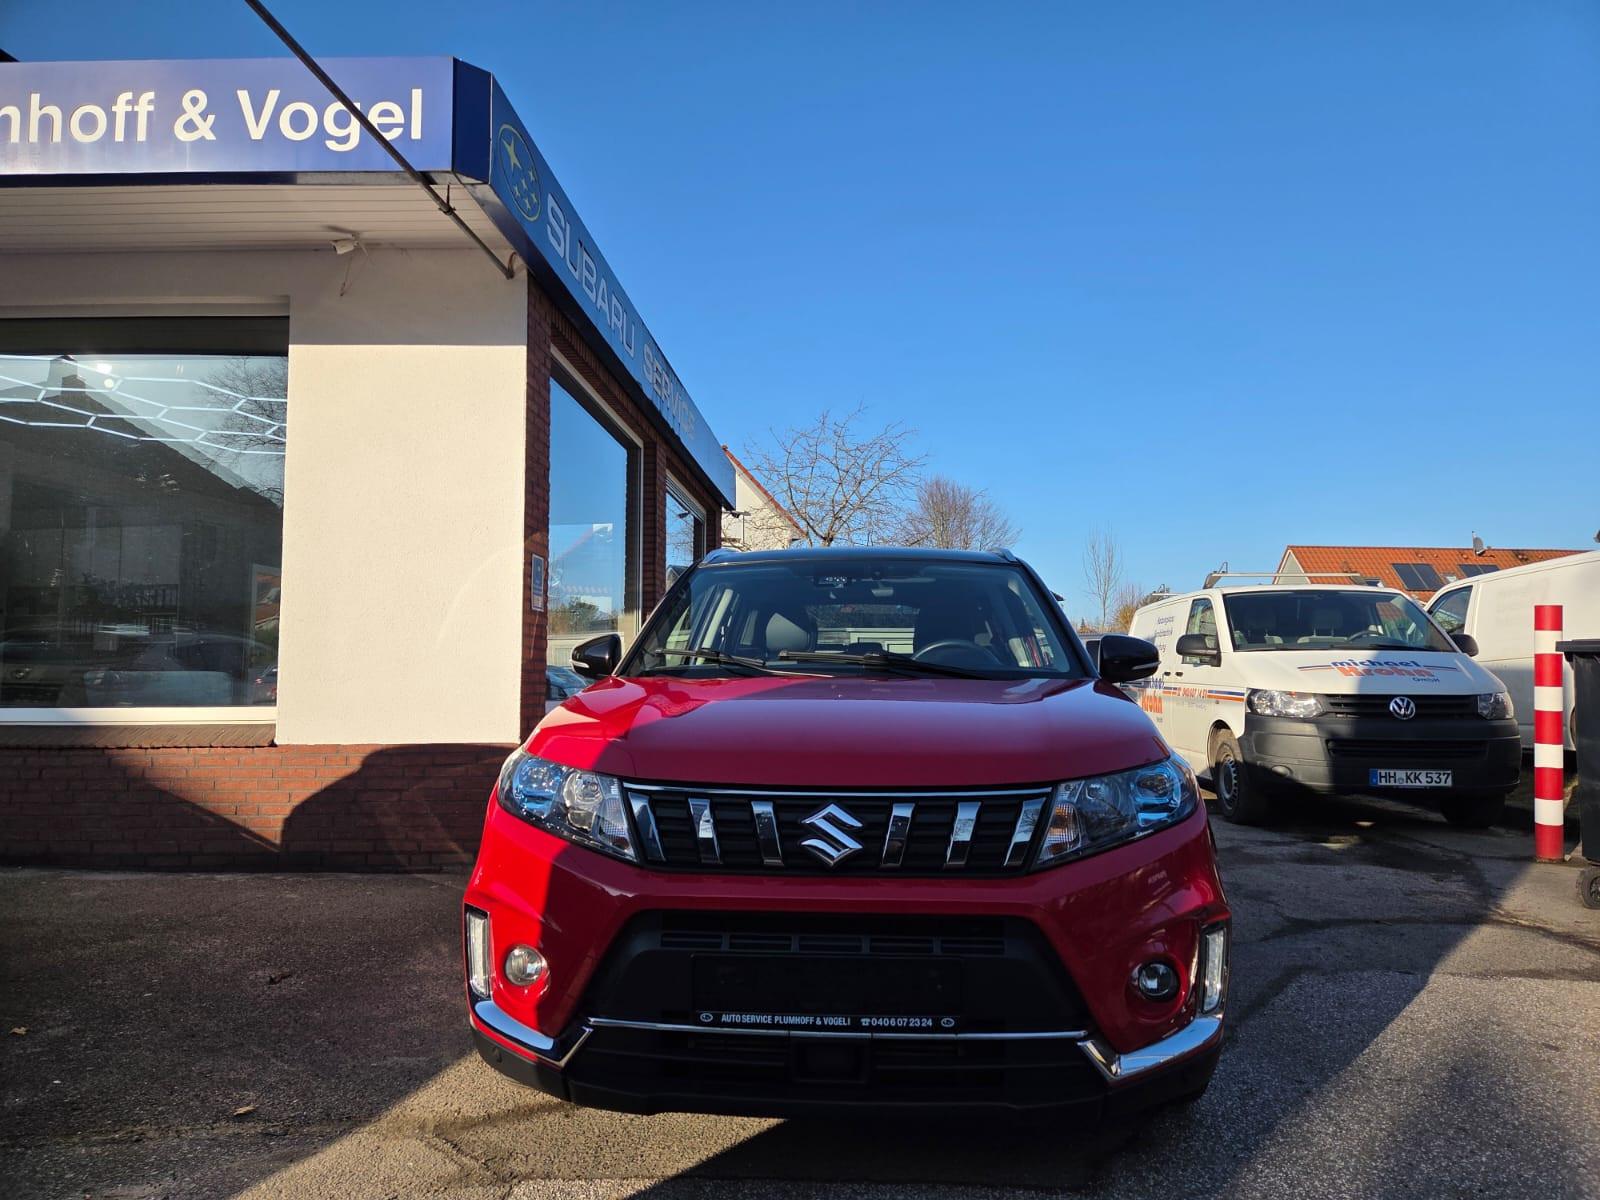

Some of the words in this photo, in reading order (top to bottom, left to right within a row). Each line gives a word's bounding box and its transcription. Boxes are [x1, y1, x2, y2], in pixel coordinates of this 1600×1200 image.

[173, 89, 217, 142] &
[236, 88, 423, 152] Vogel
[547, 193, 636, 358] SUBARU
[643, 343, 695, 440] SERVICE
[1331, 658, 1422, 668] michael
[1336, 666, 1435, 677] Krohn
[1379, 771, 1397, 784] HH
[1405, 771, 1423, 784] KK
[1425, 772, 1451, 784] 537
[774, 1015, 814, 1025] PLUMHOFF
[815, 1017, 821, 1025] &
